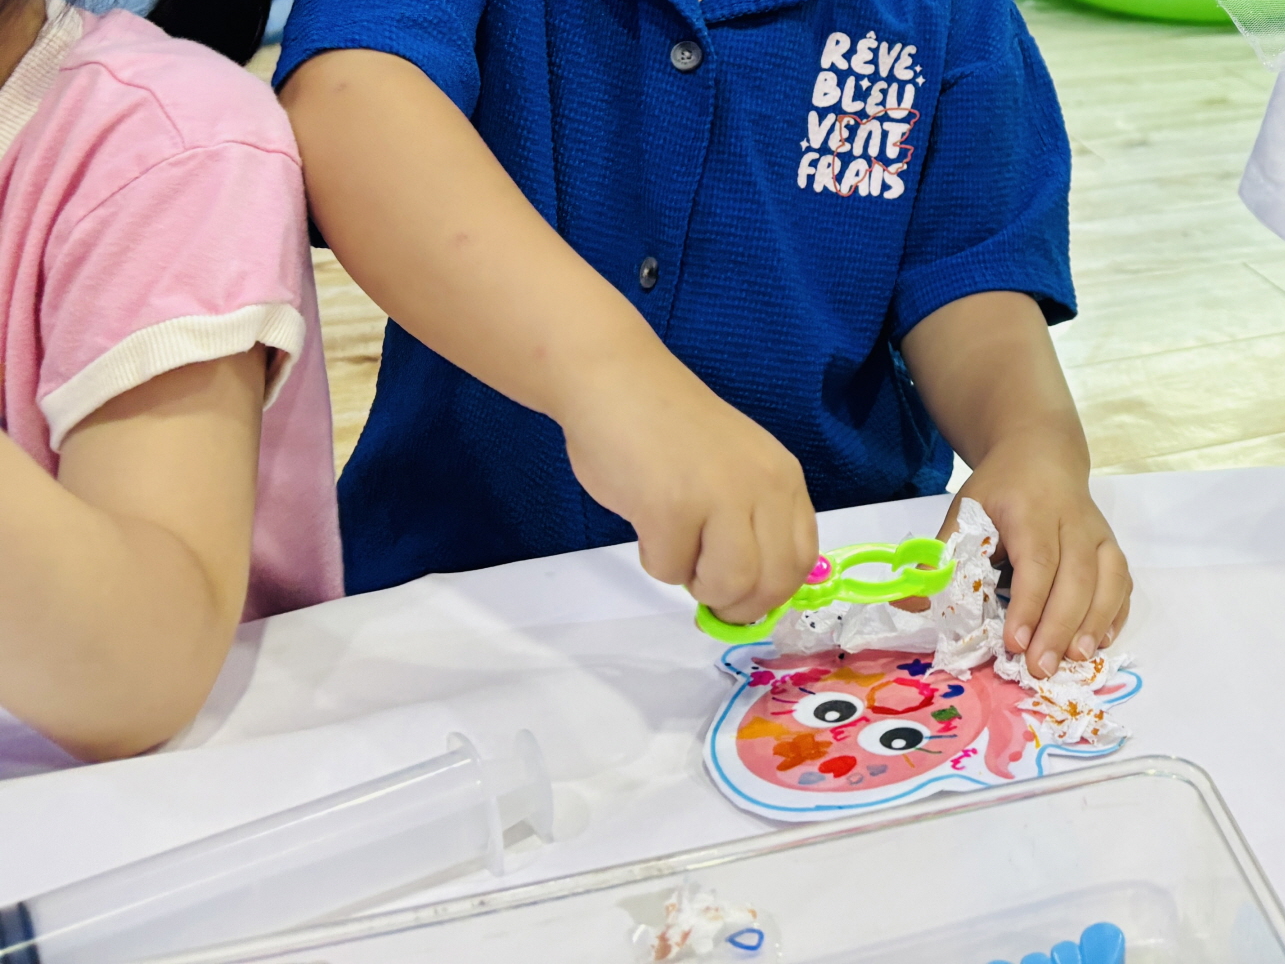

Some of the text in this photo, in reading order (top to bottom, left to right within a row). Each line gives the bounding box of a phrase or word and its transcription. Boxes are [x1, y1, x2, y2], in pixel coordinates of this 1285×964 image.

[820, 30, 918, 81] RÊVE
[811, 70, 916, 120] BLEU
[807, 110, 912, 160] VENT
[796, 151, 908, 200] FRAIS
